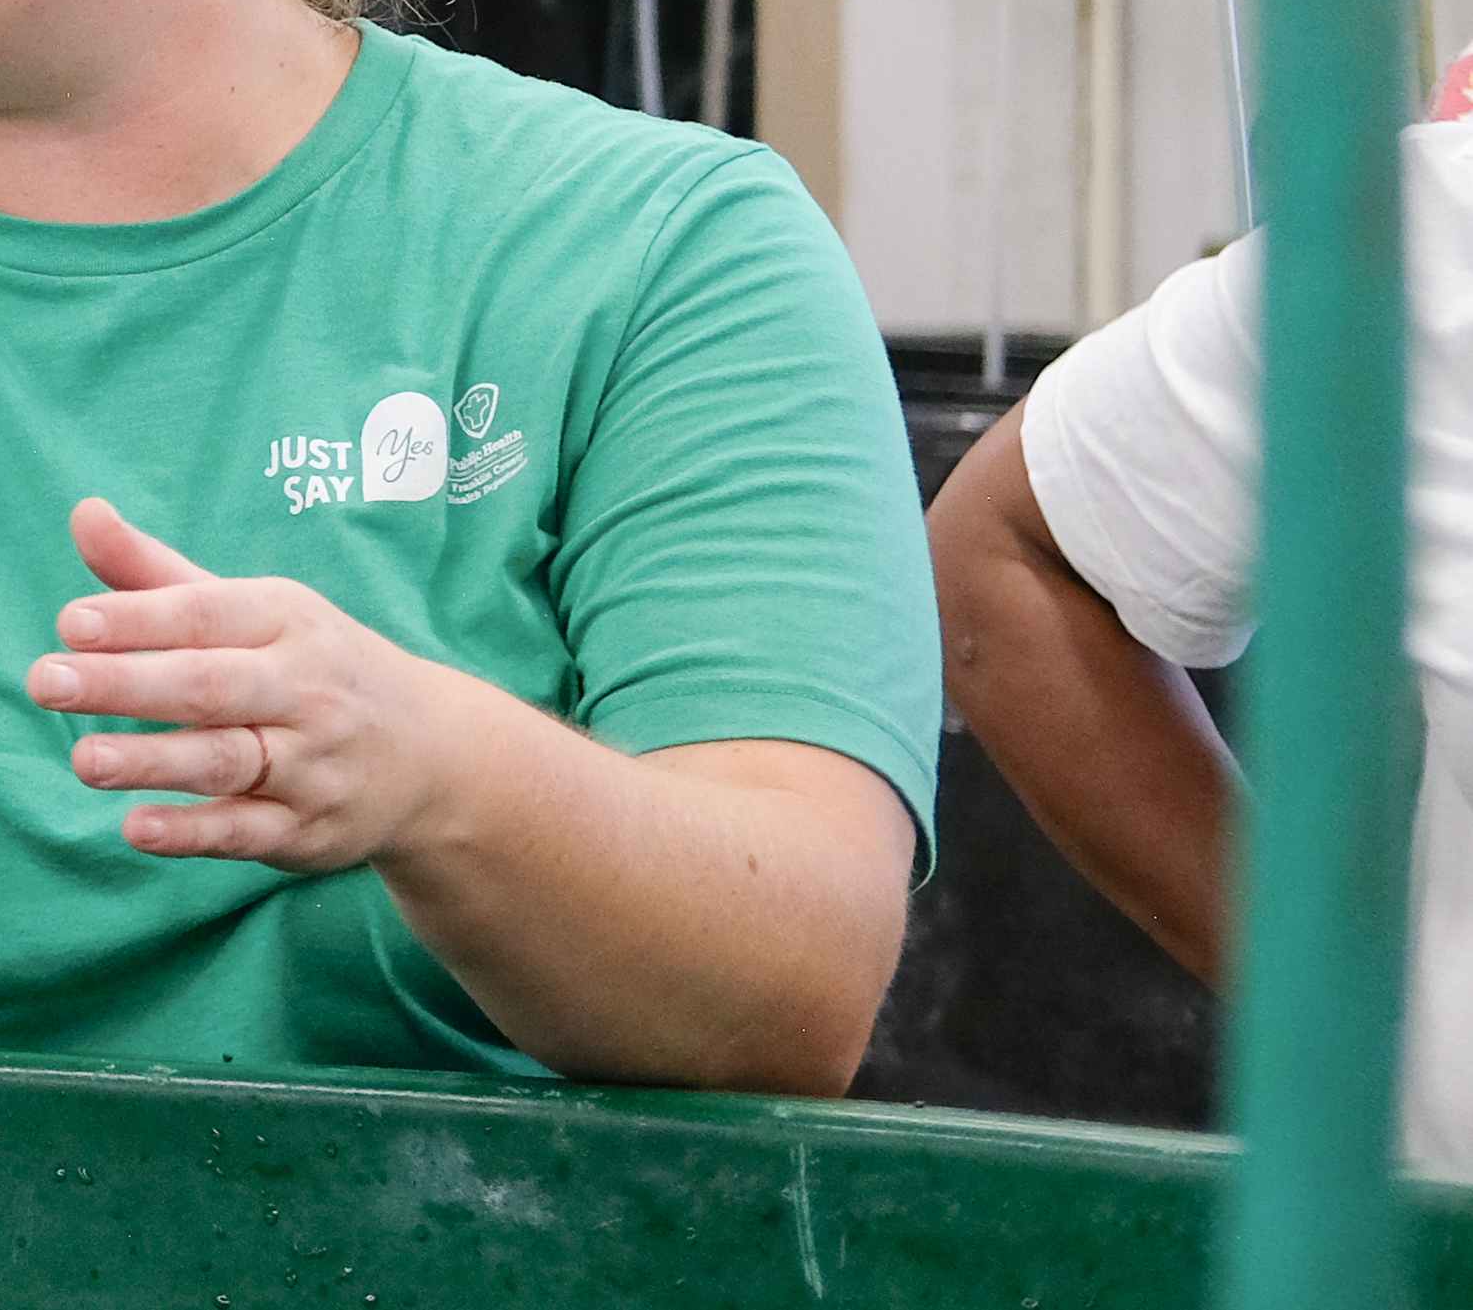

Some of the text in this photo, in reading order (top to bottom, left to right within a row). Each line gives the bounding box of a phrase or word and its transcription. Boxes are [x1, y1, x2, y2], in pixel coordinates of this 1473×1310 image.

[264, 436, 353, 477] JUST
[377, 427, 434, 483] Yes
[283, 475, 353, 515] SAY
